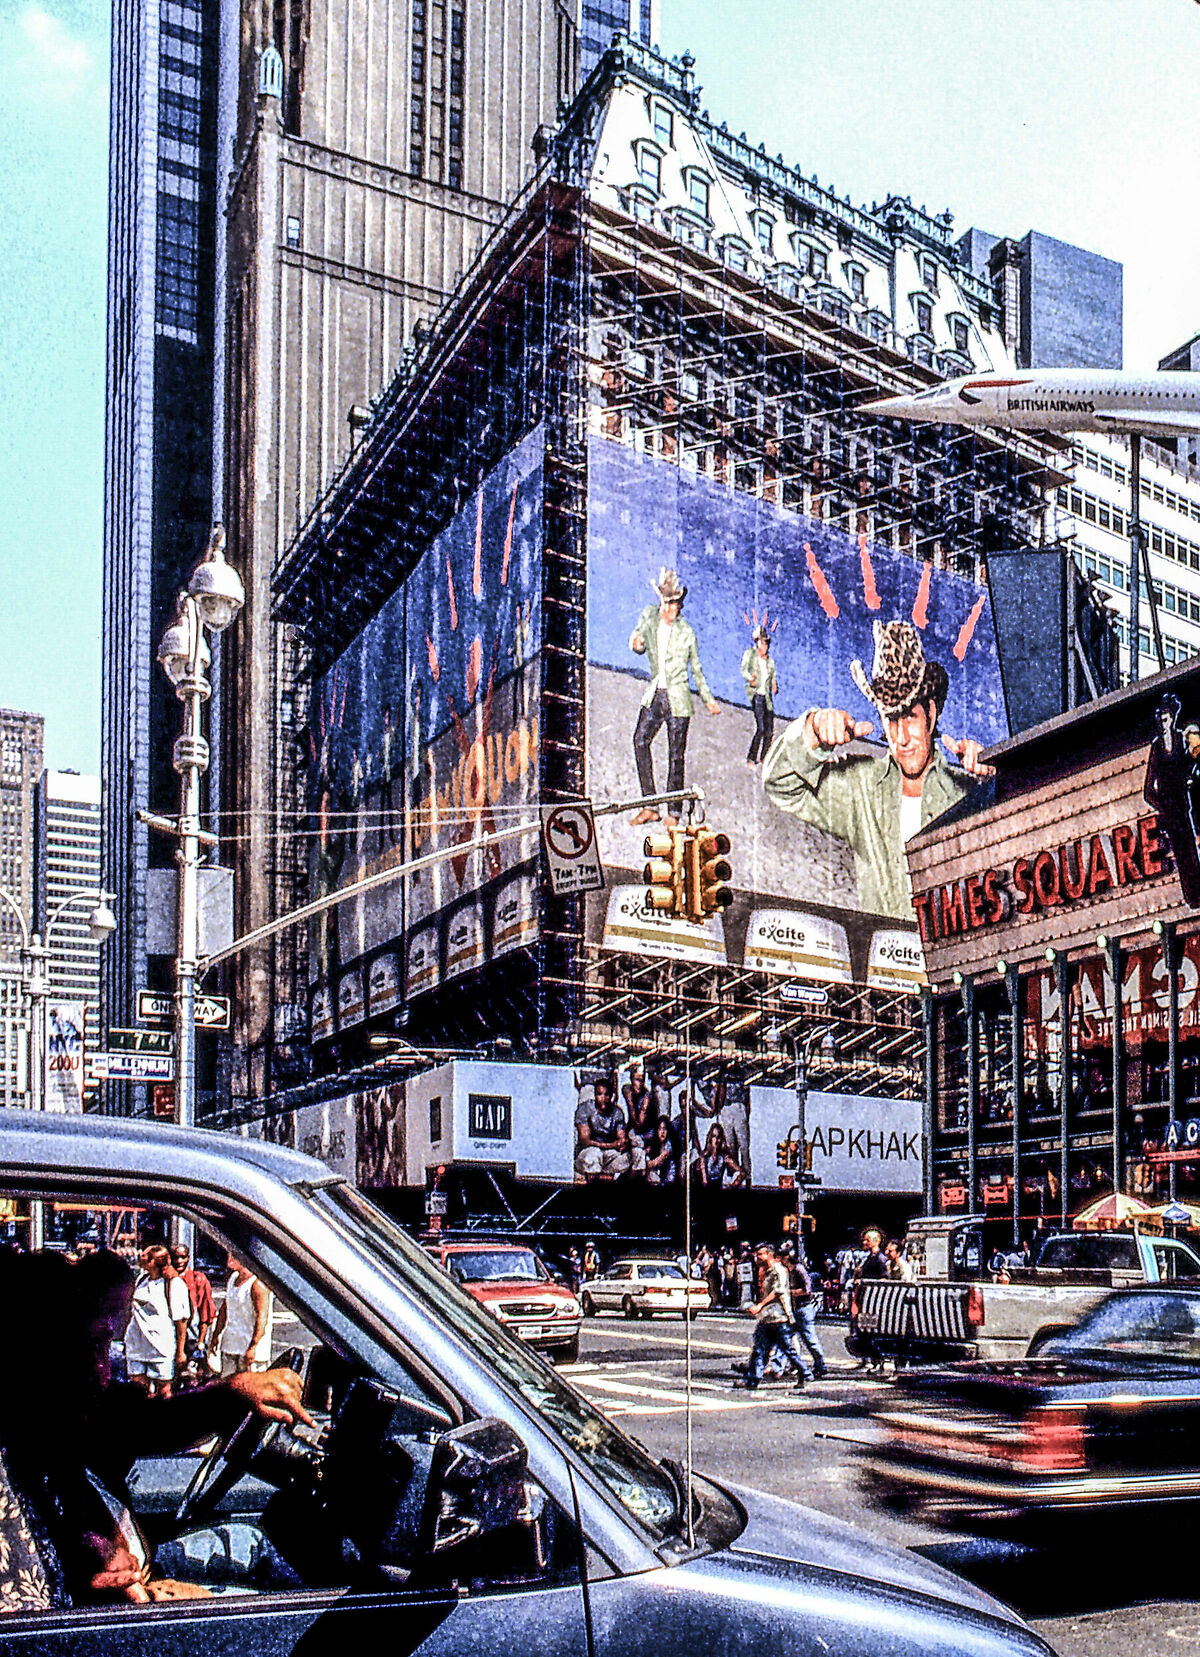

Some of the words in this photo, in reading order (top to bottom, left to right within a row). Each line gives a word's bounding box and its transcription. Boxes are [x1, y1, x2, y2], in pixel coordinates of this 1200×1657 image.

[1008, 399, 1048, 411] BRITISH
[1050, 400, 1095, 413] AIRWAYS
[911, 870, 1002, 944] TIMES
[1013, 815, 1162, 913] SQUARE
[758, 924, 806, 942] excite
[879, 944, 921, 961] excite
[475, 1103, 505, 1131] GAP
[1167, 1127, 1178, 1145] A
[1186, 1122, 1200, 1142] C
